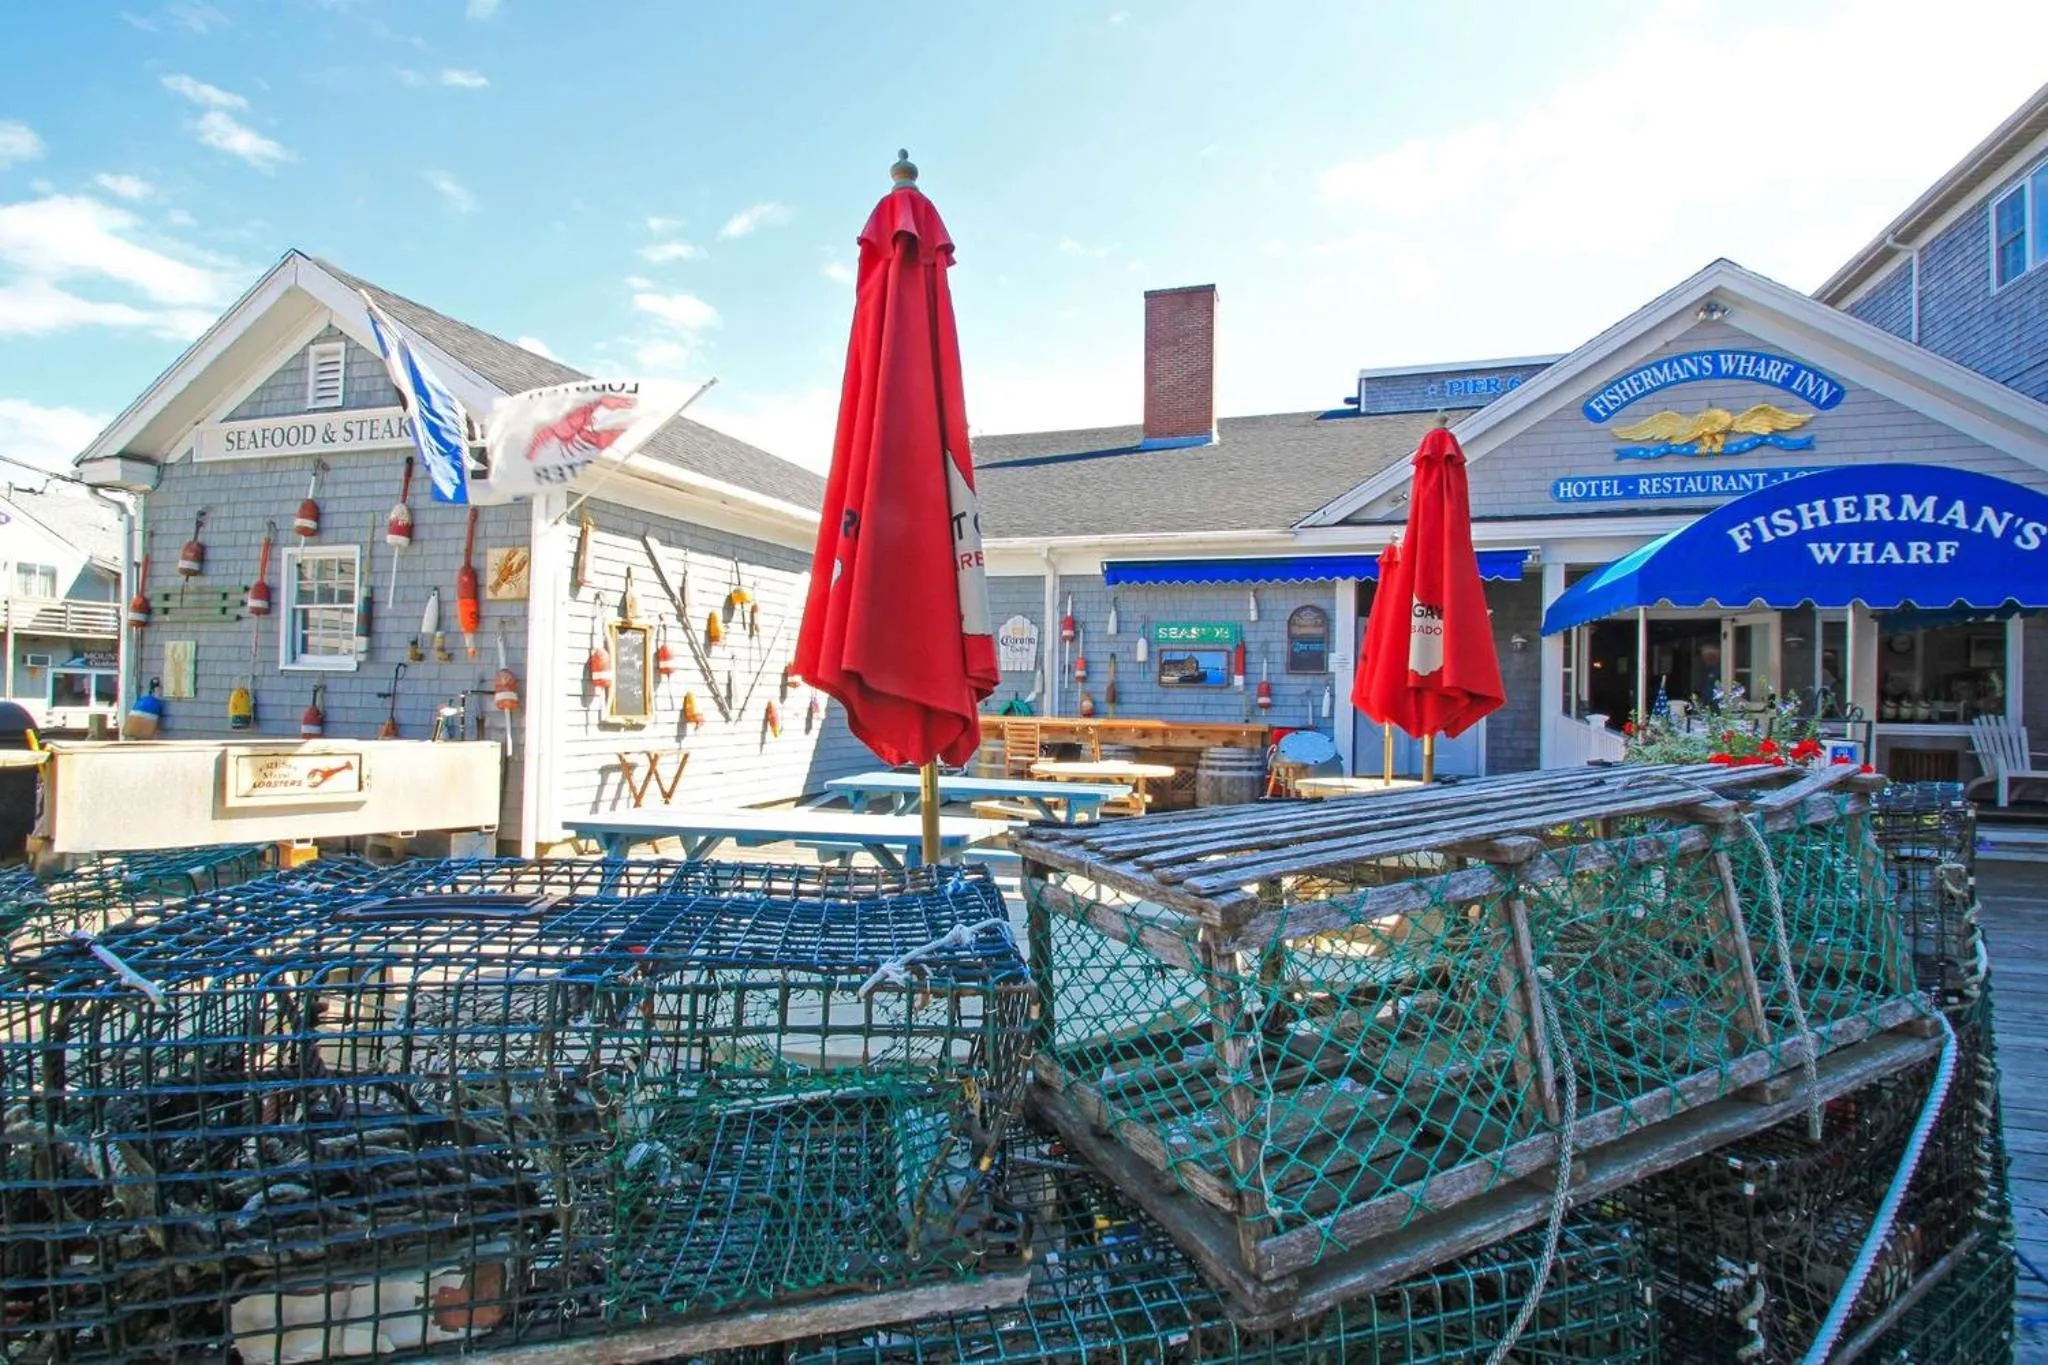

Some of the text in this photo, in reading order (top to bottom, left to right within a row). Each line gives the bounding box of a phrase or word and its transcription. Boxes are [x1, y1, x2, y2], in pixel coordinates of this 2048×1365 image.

[1446, 377, 1501, 397] PIER
[1590, 353, 1838, 417] FISHERMAN'S WHARF INN
[225, 416, 411, 452] SEAFOOD & STEAK
[1558, 478, 1624, 499] HOTEL
[1638, 472, 1768, 495] RESTAURANT
[1726, 493, 2048, 565] FISHERMAN'S WHARF
